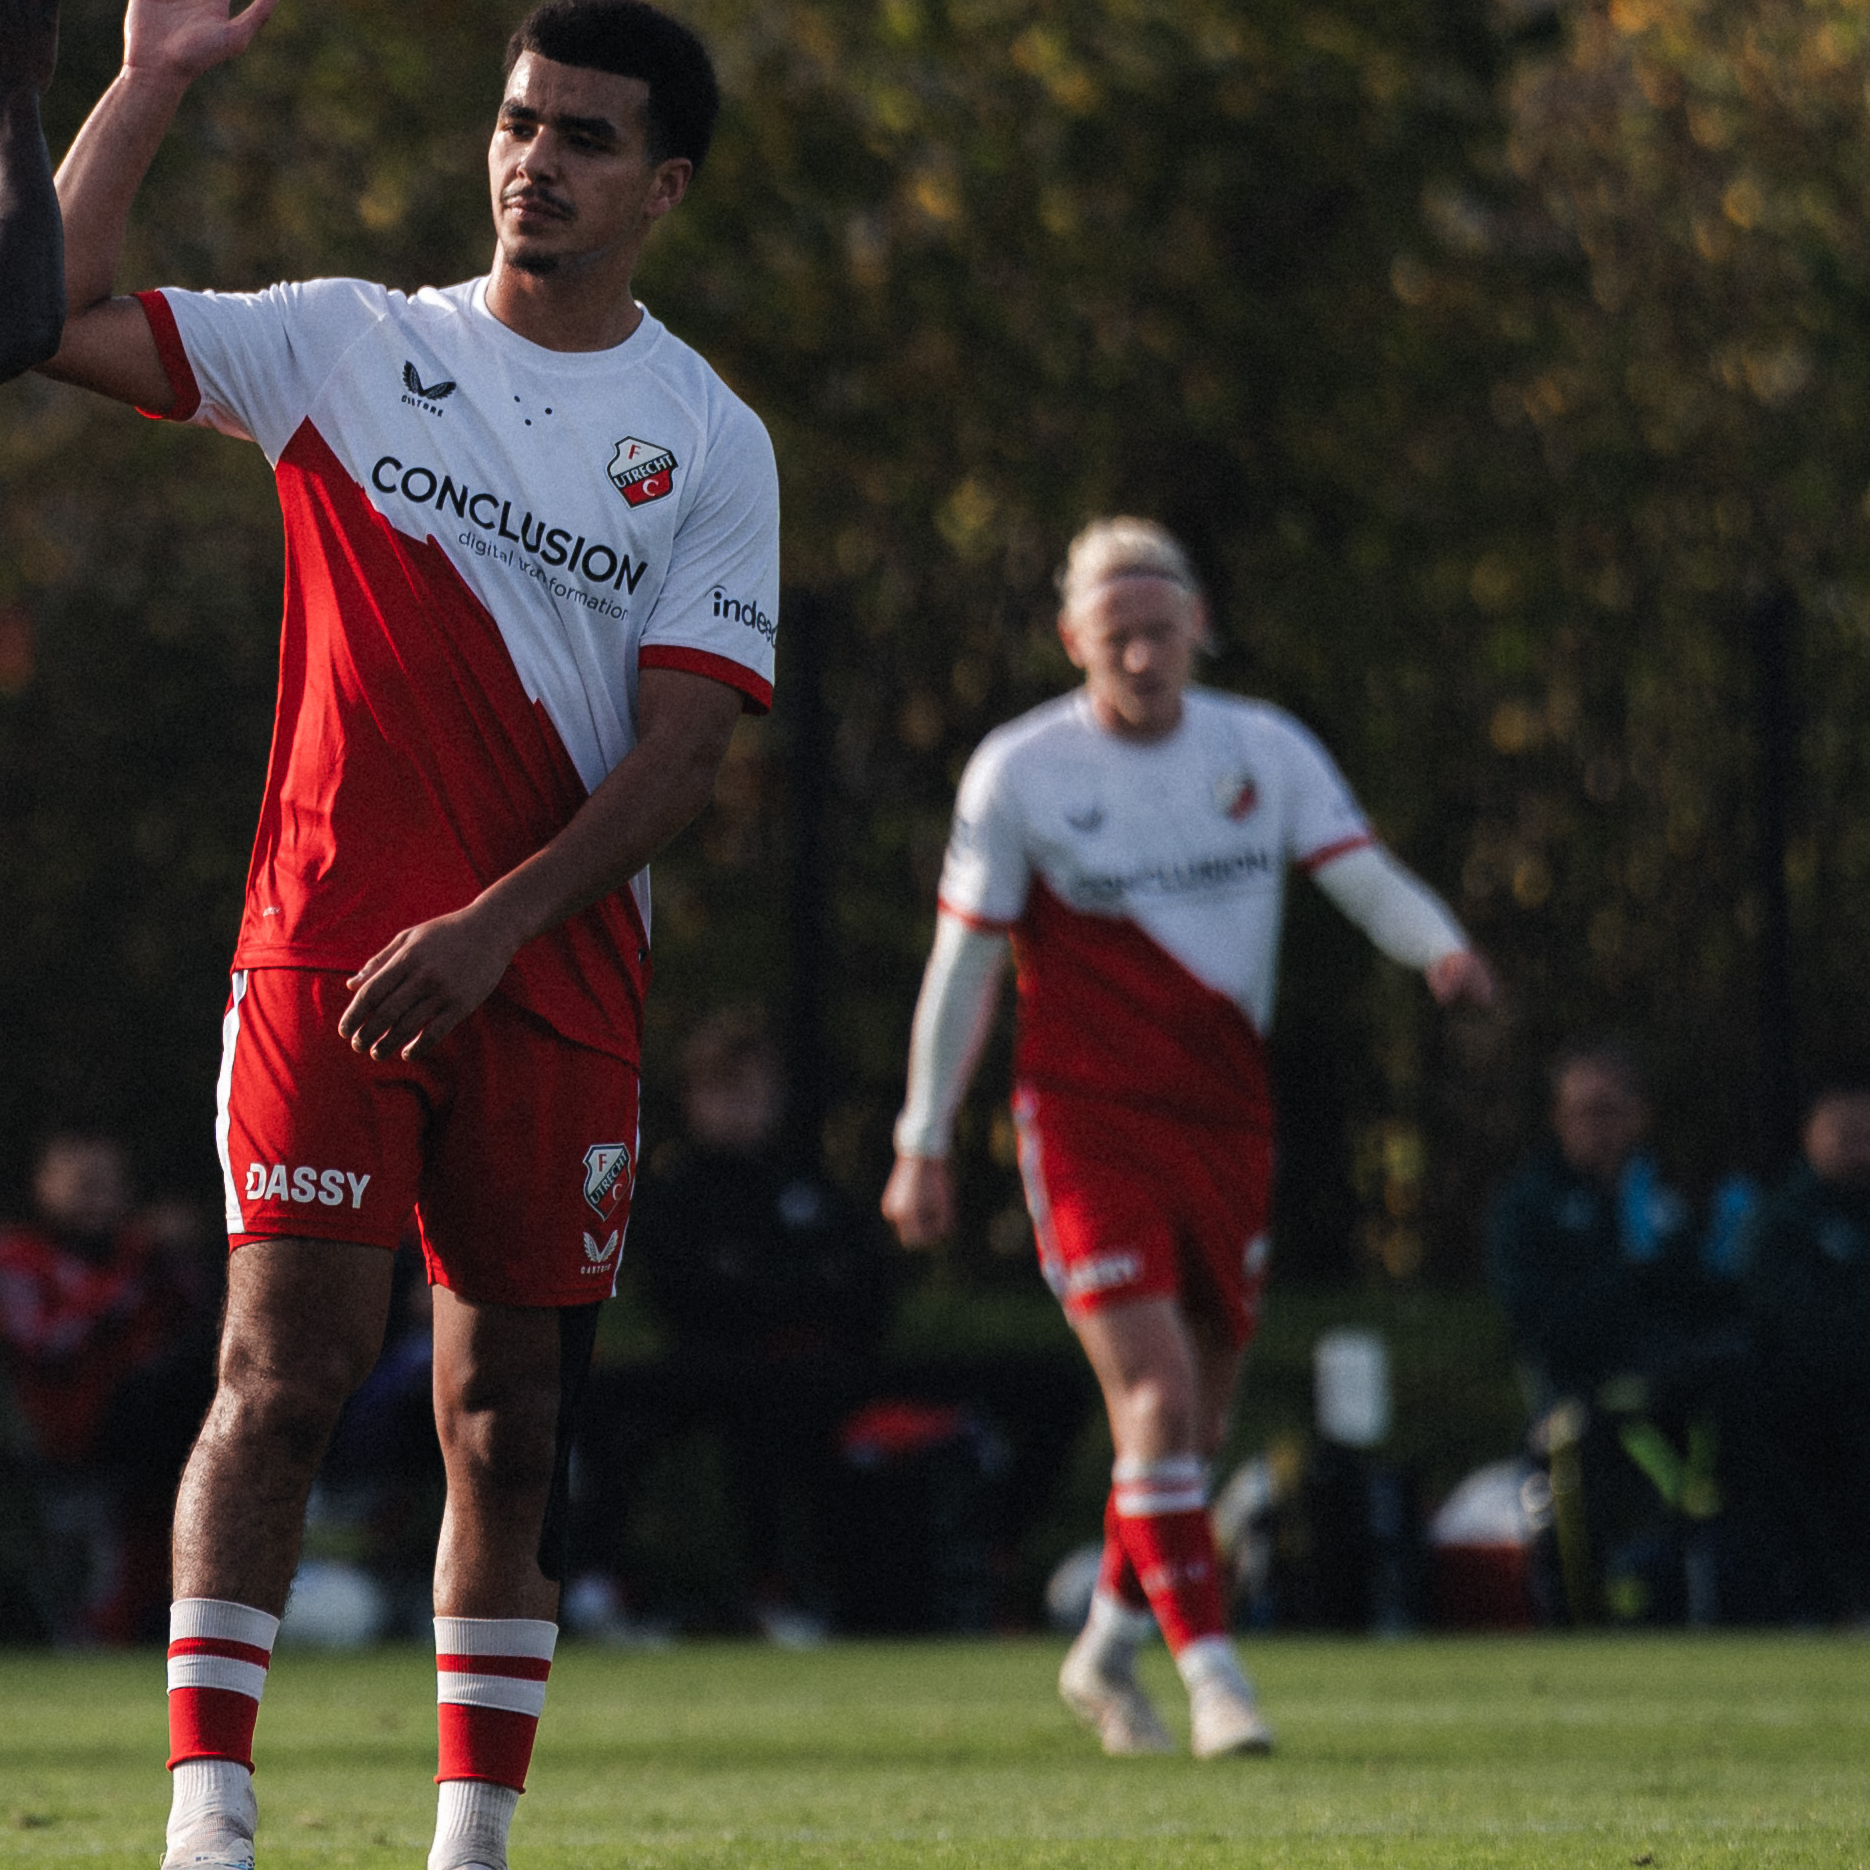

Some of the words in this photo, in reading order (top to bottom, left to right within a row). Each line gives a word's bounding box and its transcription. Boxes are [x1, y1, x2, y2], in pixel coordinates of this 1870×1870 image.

[614, 455, 673, 488] UTRECHT
[628, 444, 642, 460] F
[642, 479, 659, 497] C
[372, 456, 649, 596] CONCLUSION
[458, 531, 514, 567] digital
[518, 556, 628, 621] tranformatio
[245, 1163, 371, 1209] DASSY
[590, 1150, 629, 1205] UTRECHT
